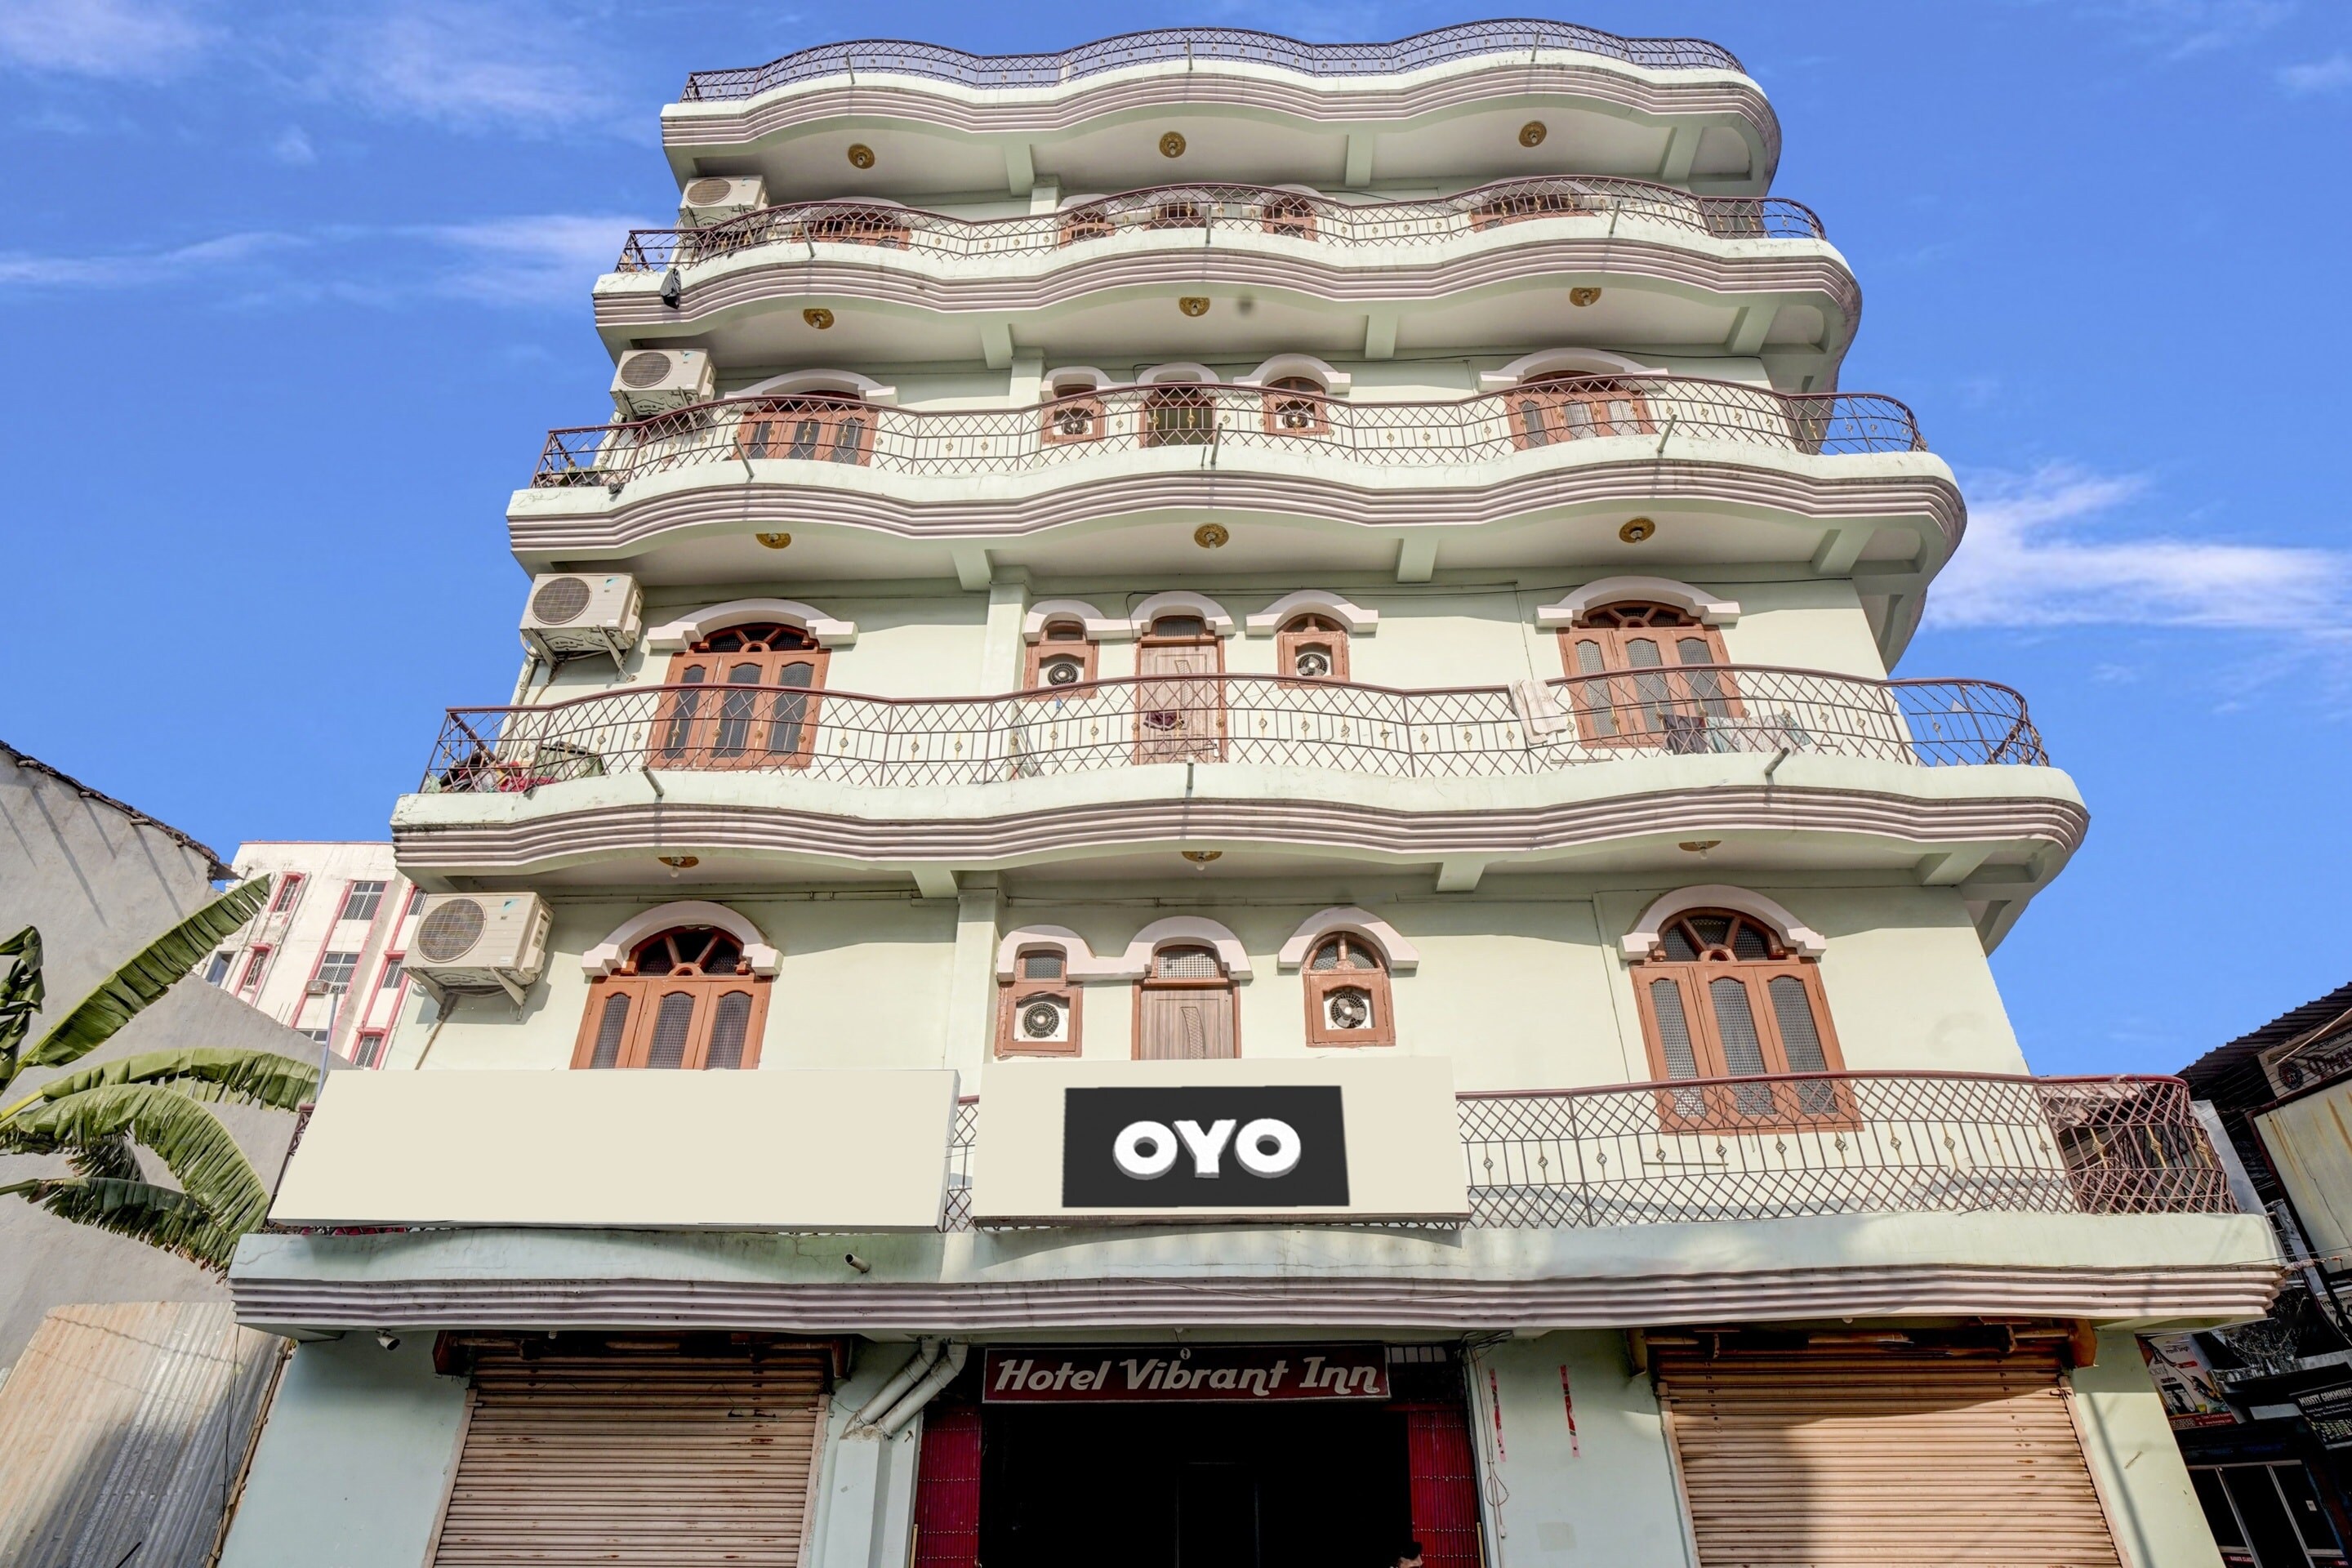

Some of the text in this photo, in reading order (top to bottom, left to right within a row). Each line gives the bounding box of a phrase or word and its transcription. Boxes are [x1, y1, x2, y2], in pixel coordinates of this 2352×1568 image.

[1112, 1118, 1301, 1180] OYO
[994, 1356, 1380, 1396] Hotel Vibrant Inn
